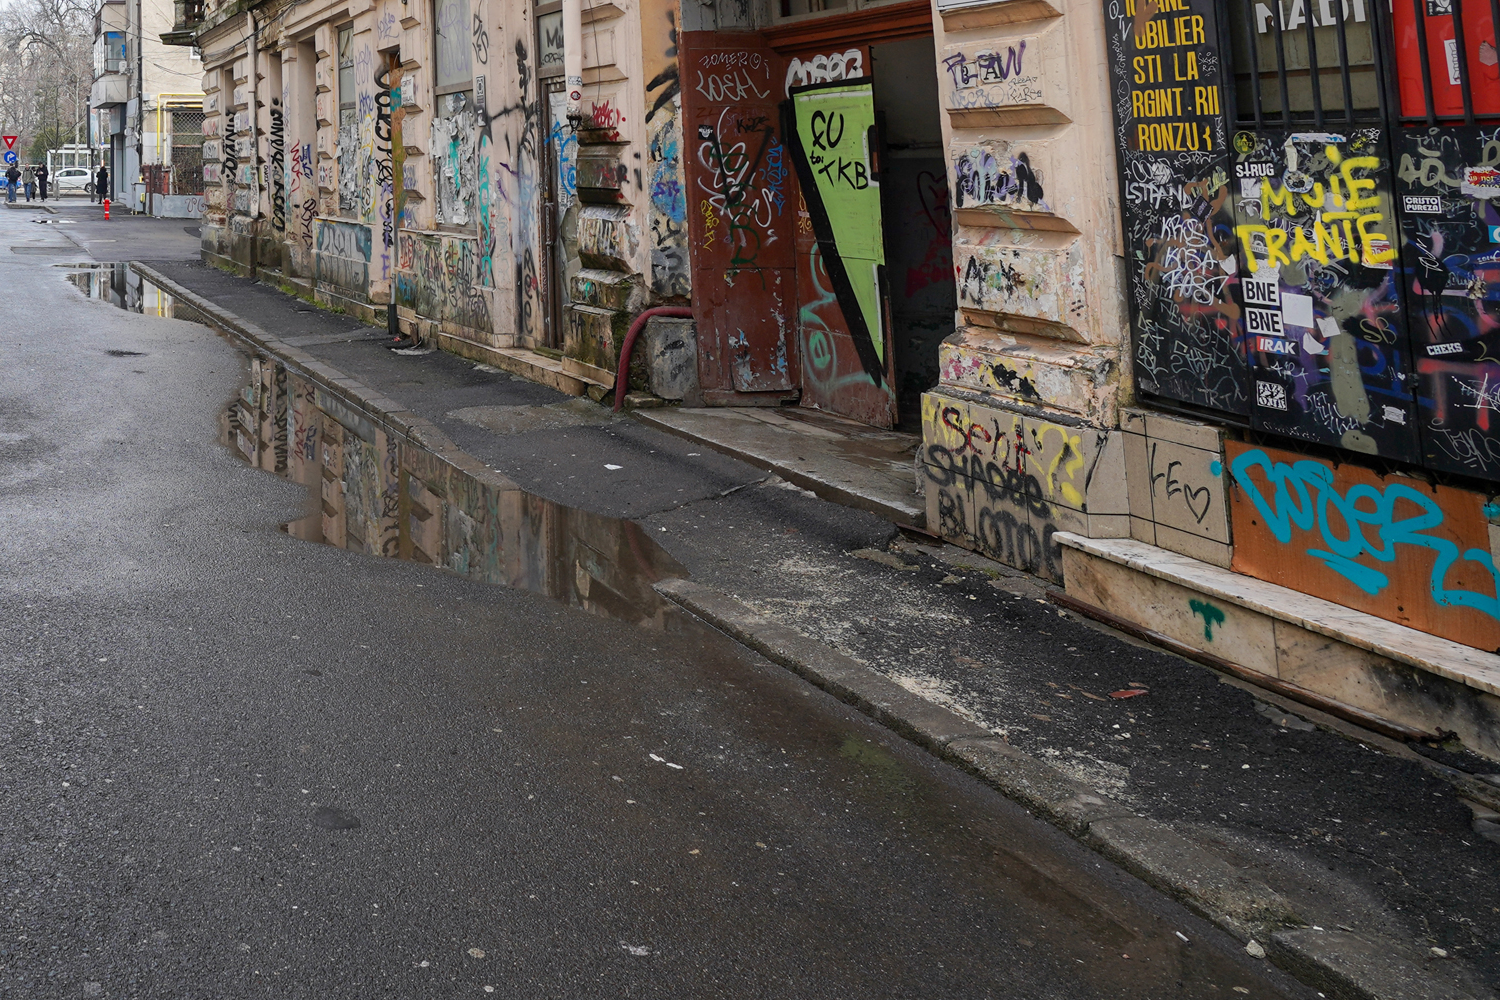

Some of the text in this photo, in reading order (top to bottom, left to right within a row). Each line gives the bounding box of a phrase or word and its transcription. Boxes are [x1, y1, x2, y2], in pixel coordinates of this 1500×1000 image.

[818, 157, 870, 190] TKB
[1406, 204, 1439, 212] PUREZA
[1245, 281, 1277, 302] BNE
[1250, 311, 1281, 333] BNE
[1259, 338, 1296, 355] IRAK
